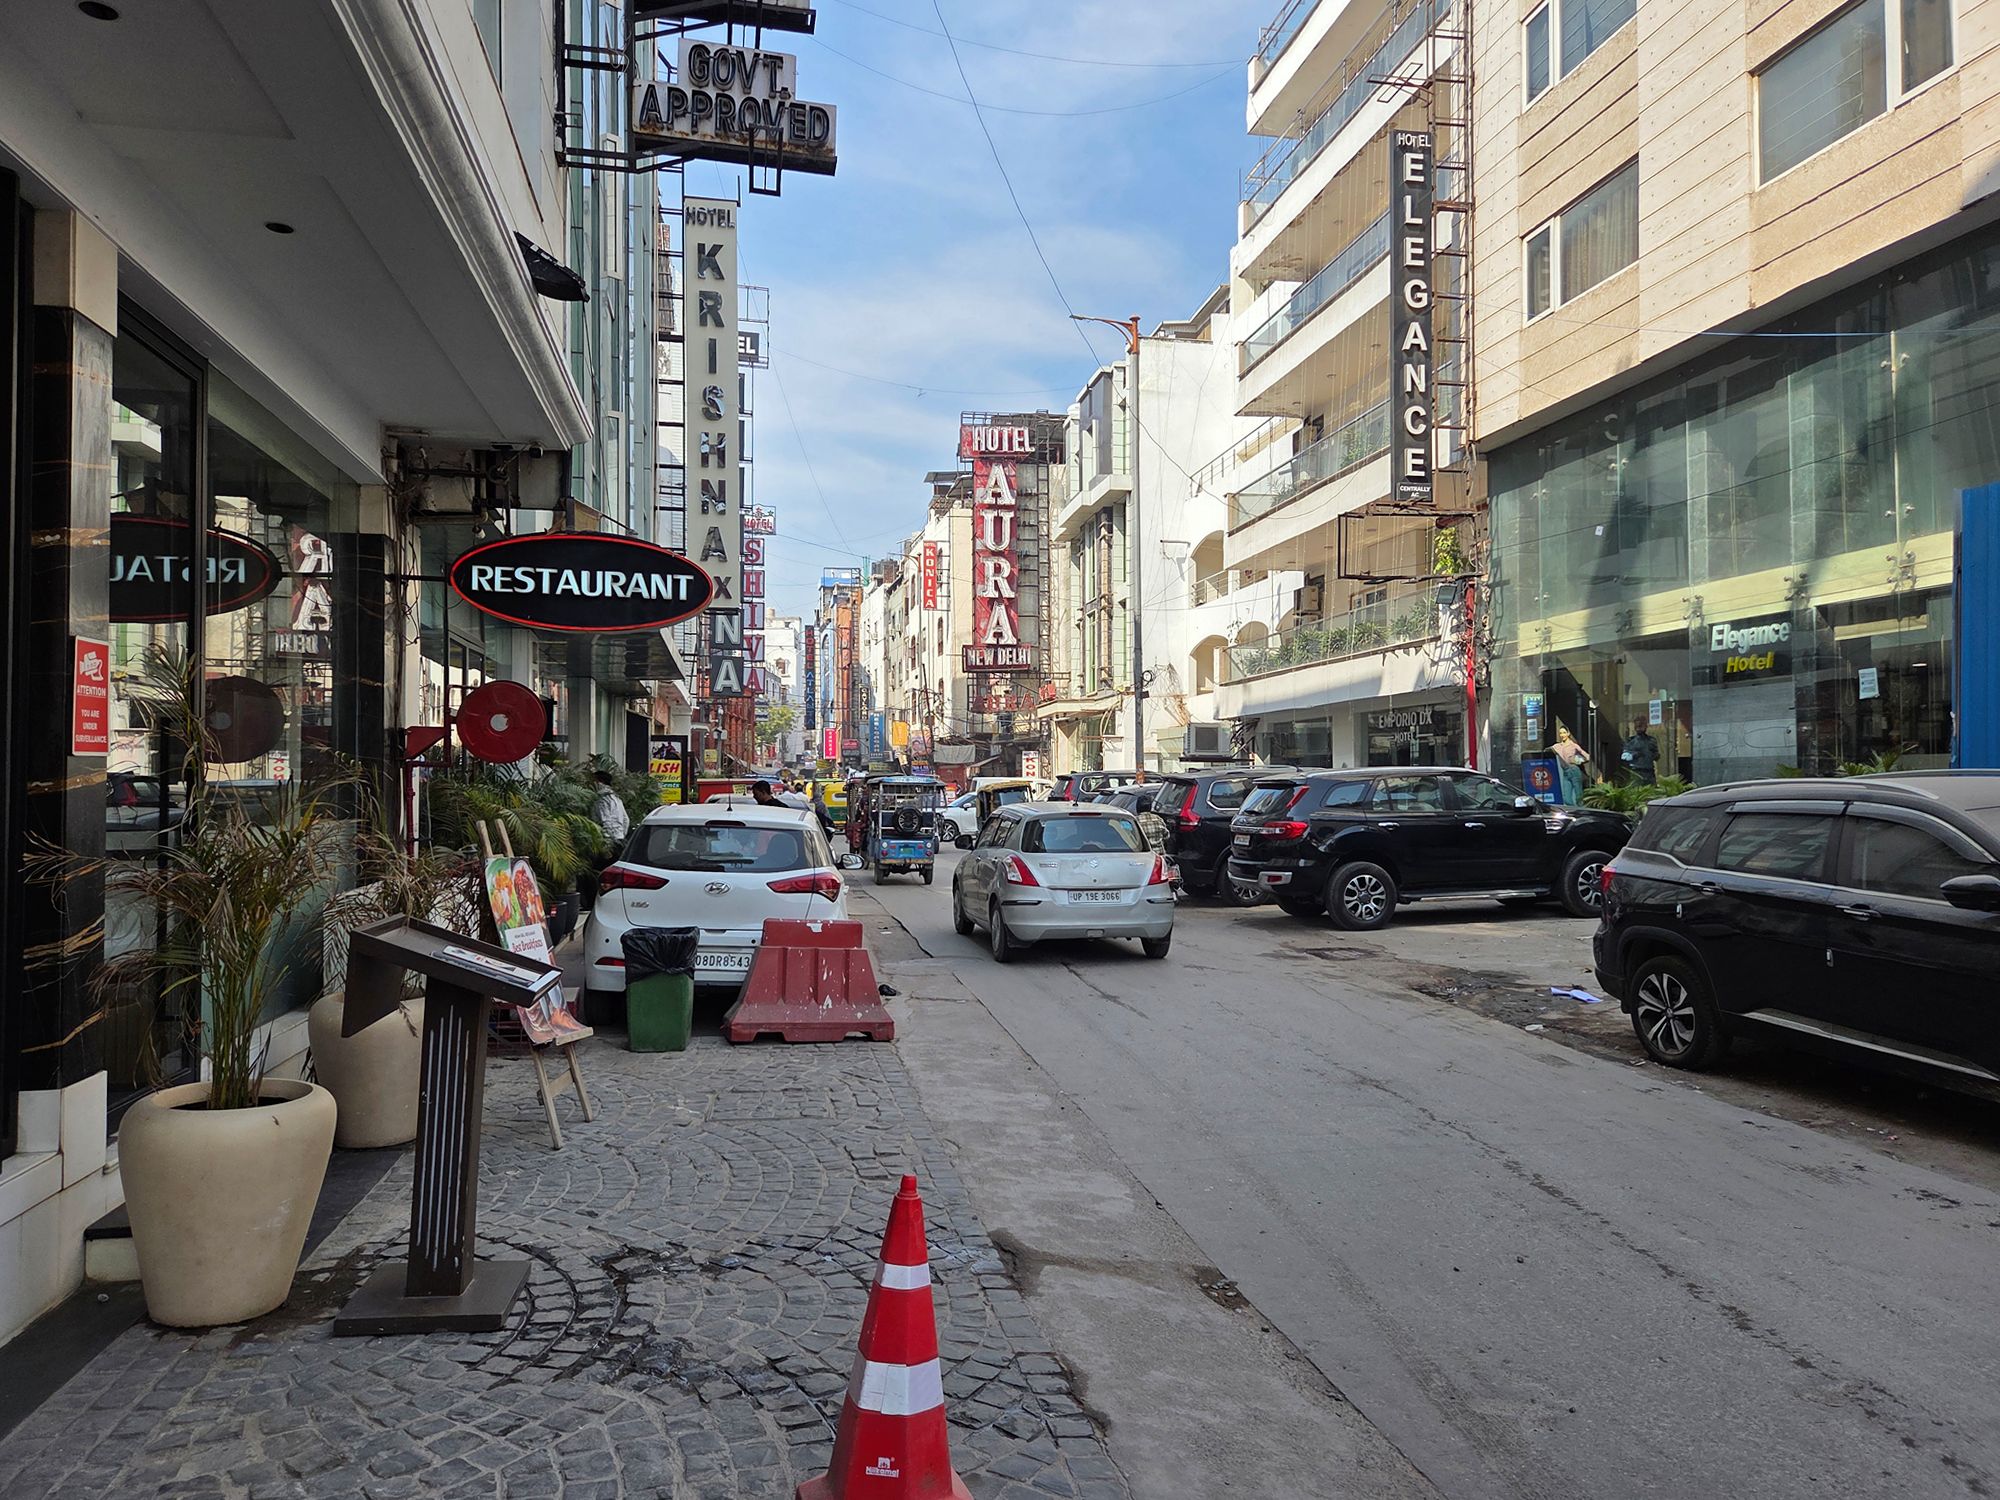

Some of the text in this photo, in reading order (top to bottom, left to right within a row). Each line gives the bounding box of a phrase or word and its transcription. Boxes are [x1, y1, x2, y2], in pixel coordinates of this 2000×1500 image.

[688, 43, 792, 99] GOVT.
[638, 83, 831, 147] APPROVED
[1397, 132, 1432, 148] HOTEL
[685, 206, 736, 229] HOTEL
[1402, 152, 1428, 477] ELEGANCE
[697, 242, 728, 563] KRISHNA
[972, 424, 1035, 453] HOTEL
[744, 518, 772, 529] HOTEL
[980, 462, 1017, 645] AURA
[471, 564, 694, 601] RESTAURANT
[925, 548, 935, 608] KONICA
[744, 538, 763, 692] SHIVA
[806, 629, 814, 669] HOTEL
[1710, 622, 1791, 654] Elegance
[966, 646, 1031, 666] NEW DELHI
[1726, 651, 1775, 674] Hotel
[77, 684, 106, 696] ATTENTION
[81, 709, 100, 718] YOU ARE
[1378, 707, 1433, 728] EMPORIO DX
[82, 722, 98, 730] UNDER
[1394, 731, 1415, 742] HOTEL
[75, 734, 107, 744] SURVEILLANCE
[1073, 892, 1120, 901] UP 19E 3066
